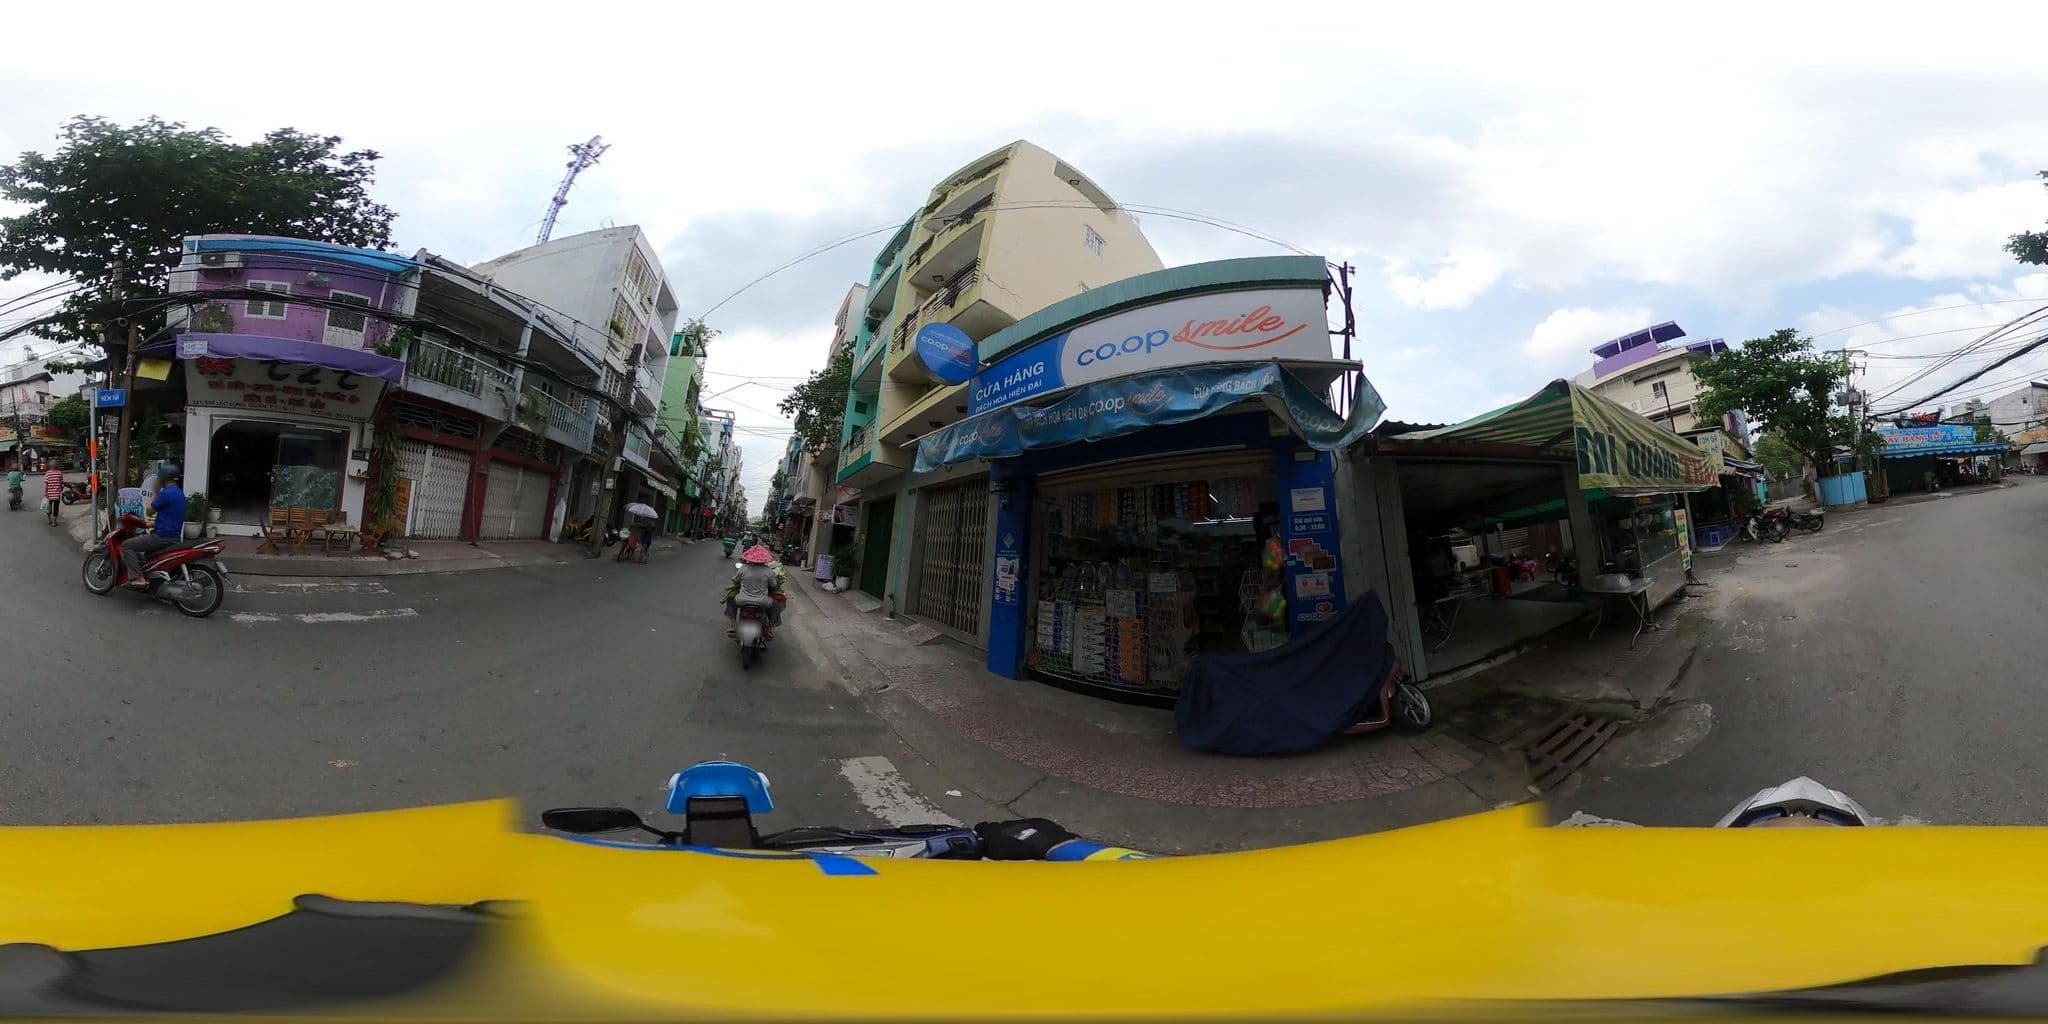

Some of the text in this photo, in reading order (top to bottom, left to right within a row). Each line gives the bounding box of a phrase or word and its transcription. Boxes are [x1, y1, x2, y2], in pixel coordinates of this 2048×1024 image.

[1077, 305, 1307, 367] co.op smile
[975, 361, 1045, 402] CỬA HÀNG
[1088, 396, 1126, 417] co.op
[1912, 410, 1937, 425] Tiger
